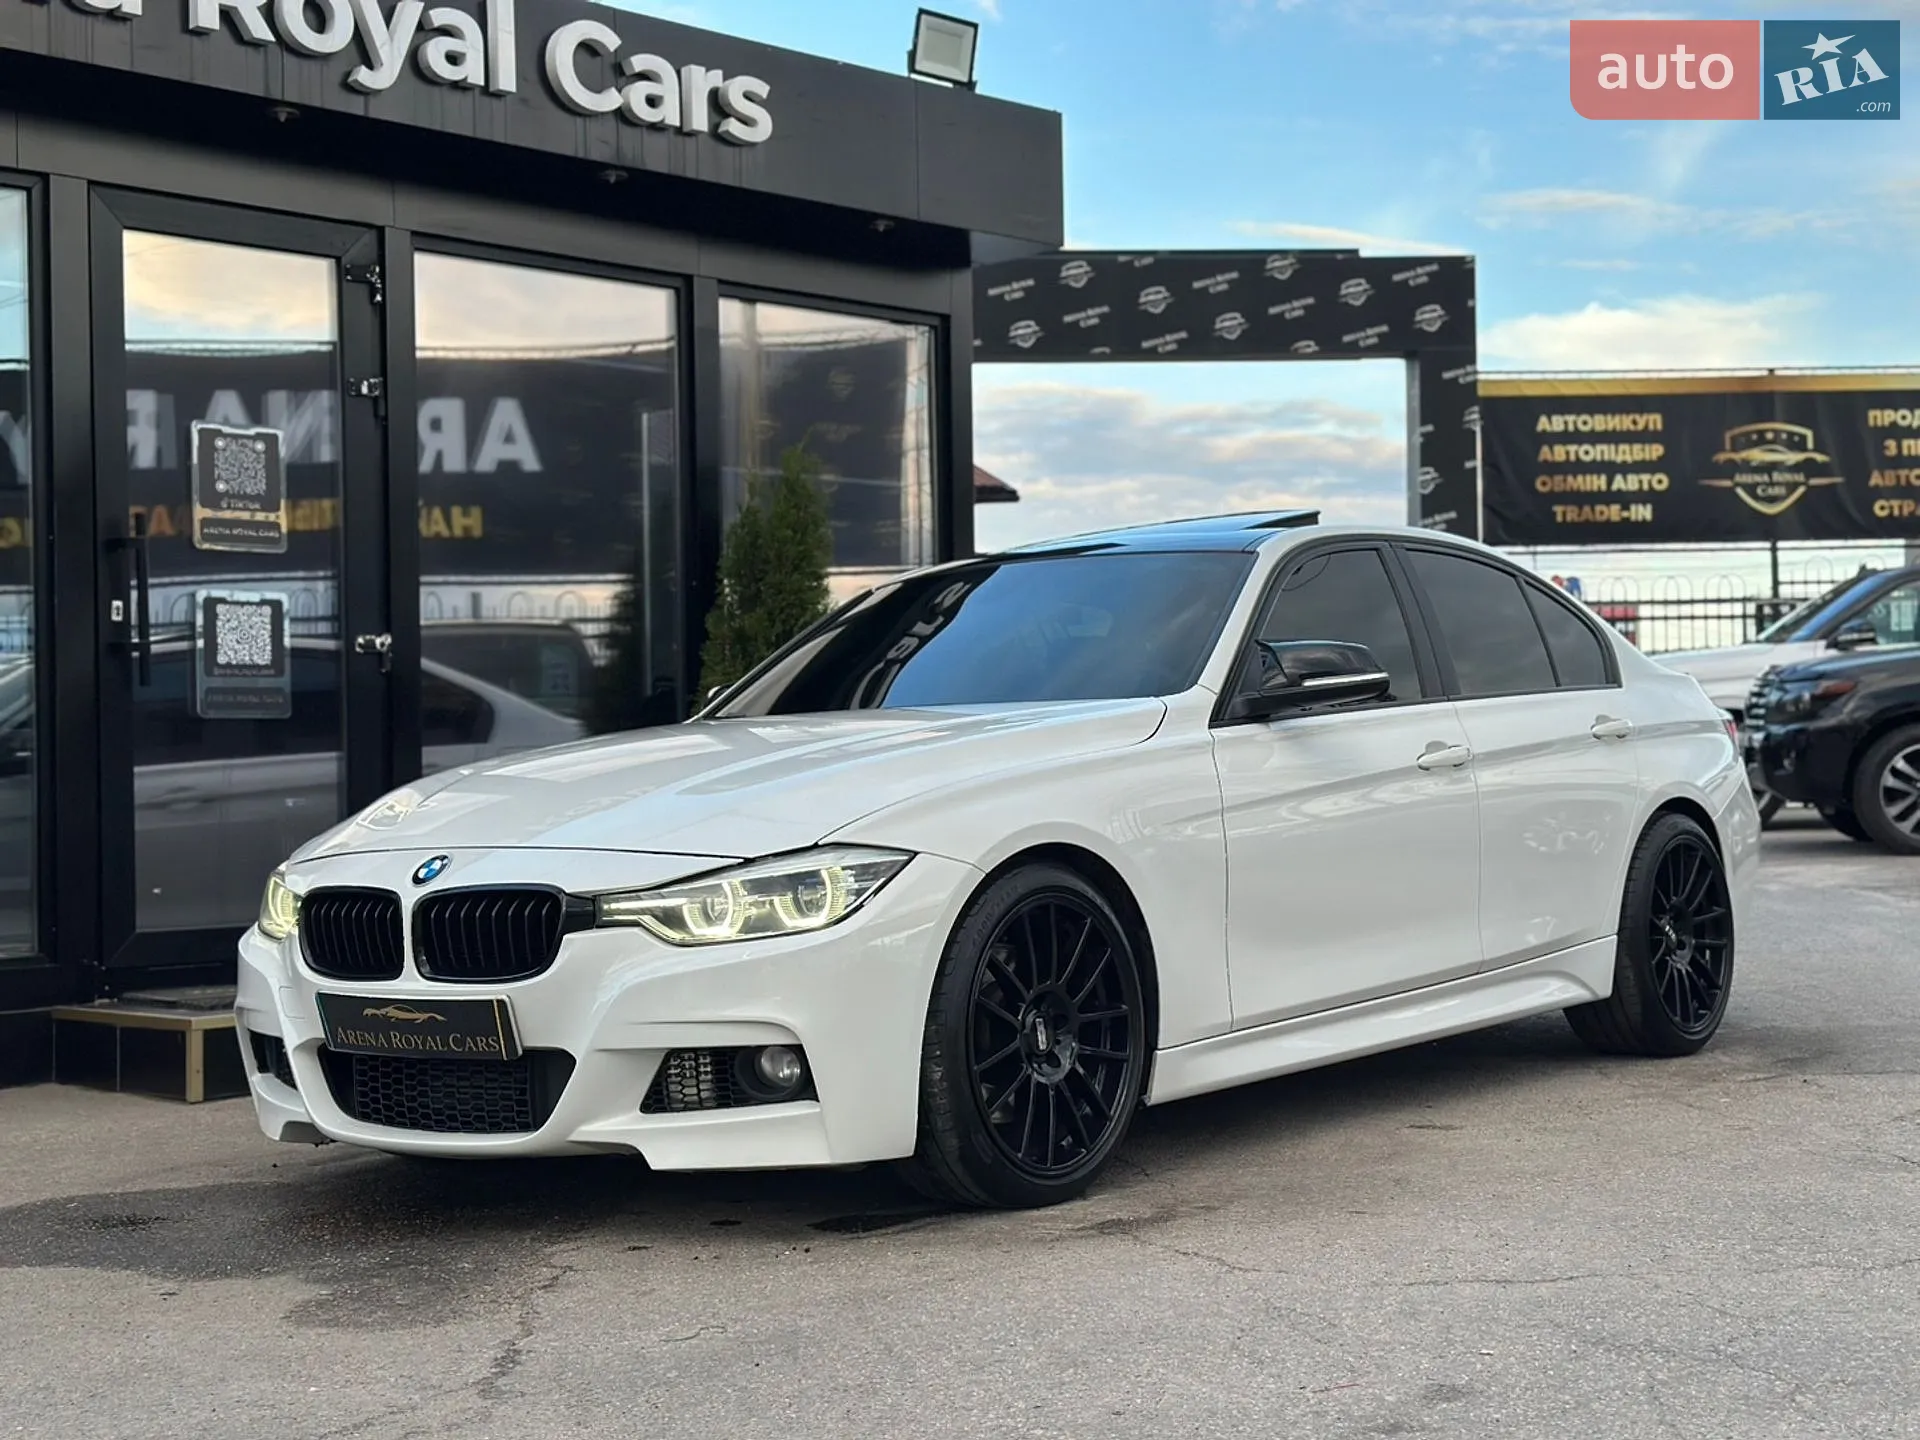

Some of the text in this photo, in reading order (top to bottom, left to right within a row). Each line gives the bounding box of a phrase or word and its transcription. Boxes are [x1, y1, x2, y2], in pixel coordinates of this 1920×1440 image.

[545, 19, 773, 145] Cars
[1536, 412, 1663, 432] АВТОВИКУП
[1538, 443, 1665, 464] АВТОПІДБІР
[1535, 472, 1670, 493] ОБМІН АВТО
[1552, 503, 1653, 523] TRADE-IN
[336, 1026, 501, 1052] ARENA ROYAL CARS
